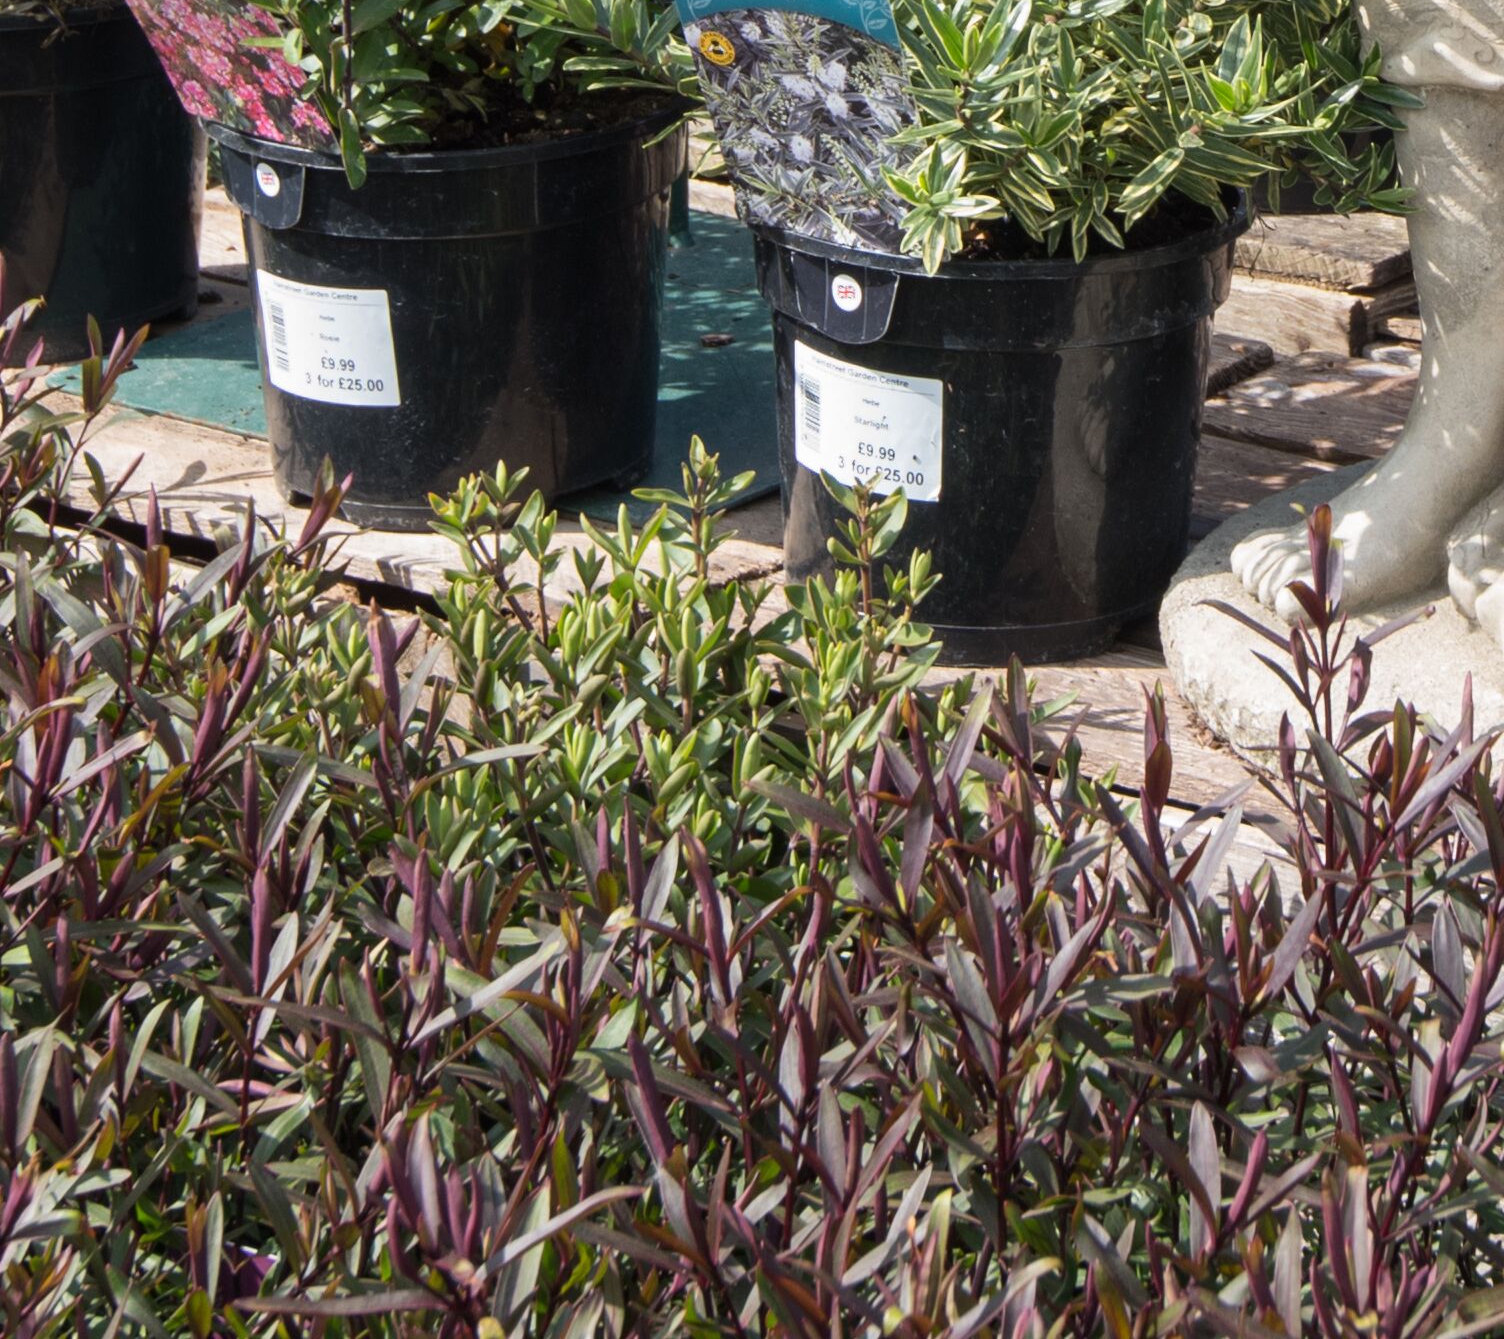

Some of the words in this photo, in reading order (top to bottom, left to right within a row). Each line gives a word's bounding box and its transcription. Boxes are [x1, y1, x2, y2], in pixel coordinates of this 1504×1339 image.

[331, 292, 359, 301] Centre
[321, 356, 356, 372] £9.99
[305, 372, 312, 384] 3
[317, 374, 333, 388] for
[338, 377, 384, 392] £25.00
[847, 367, 877, 382] Garden
[880, 376, 910, 388] Centre
[854, 415, 890, 431] Starlight
[858, 441, 896, 461] £9.99
[838, 455, 845, 469] 3
[851, 459, 871, 475] for
